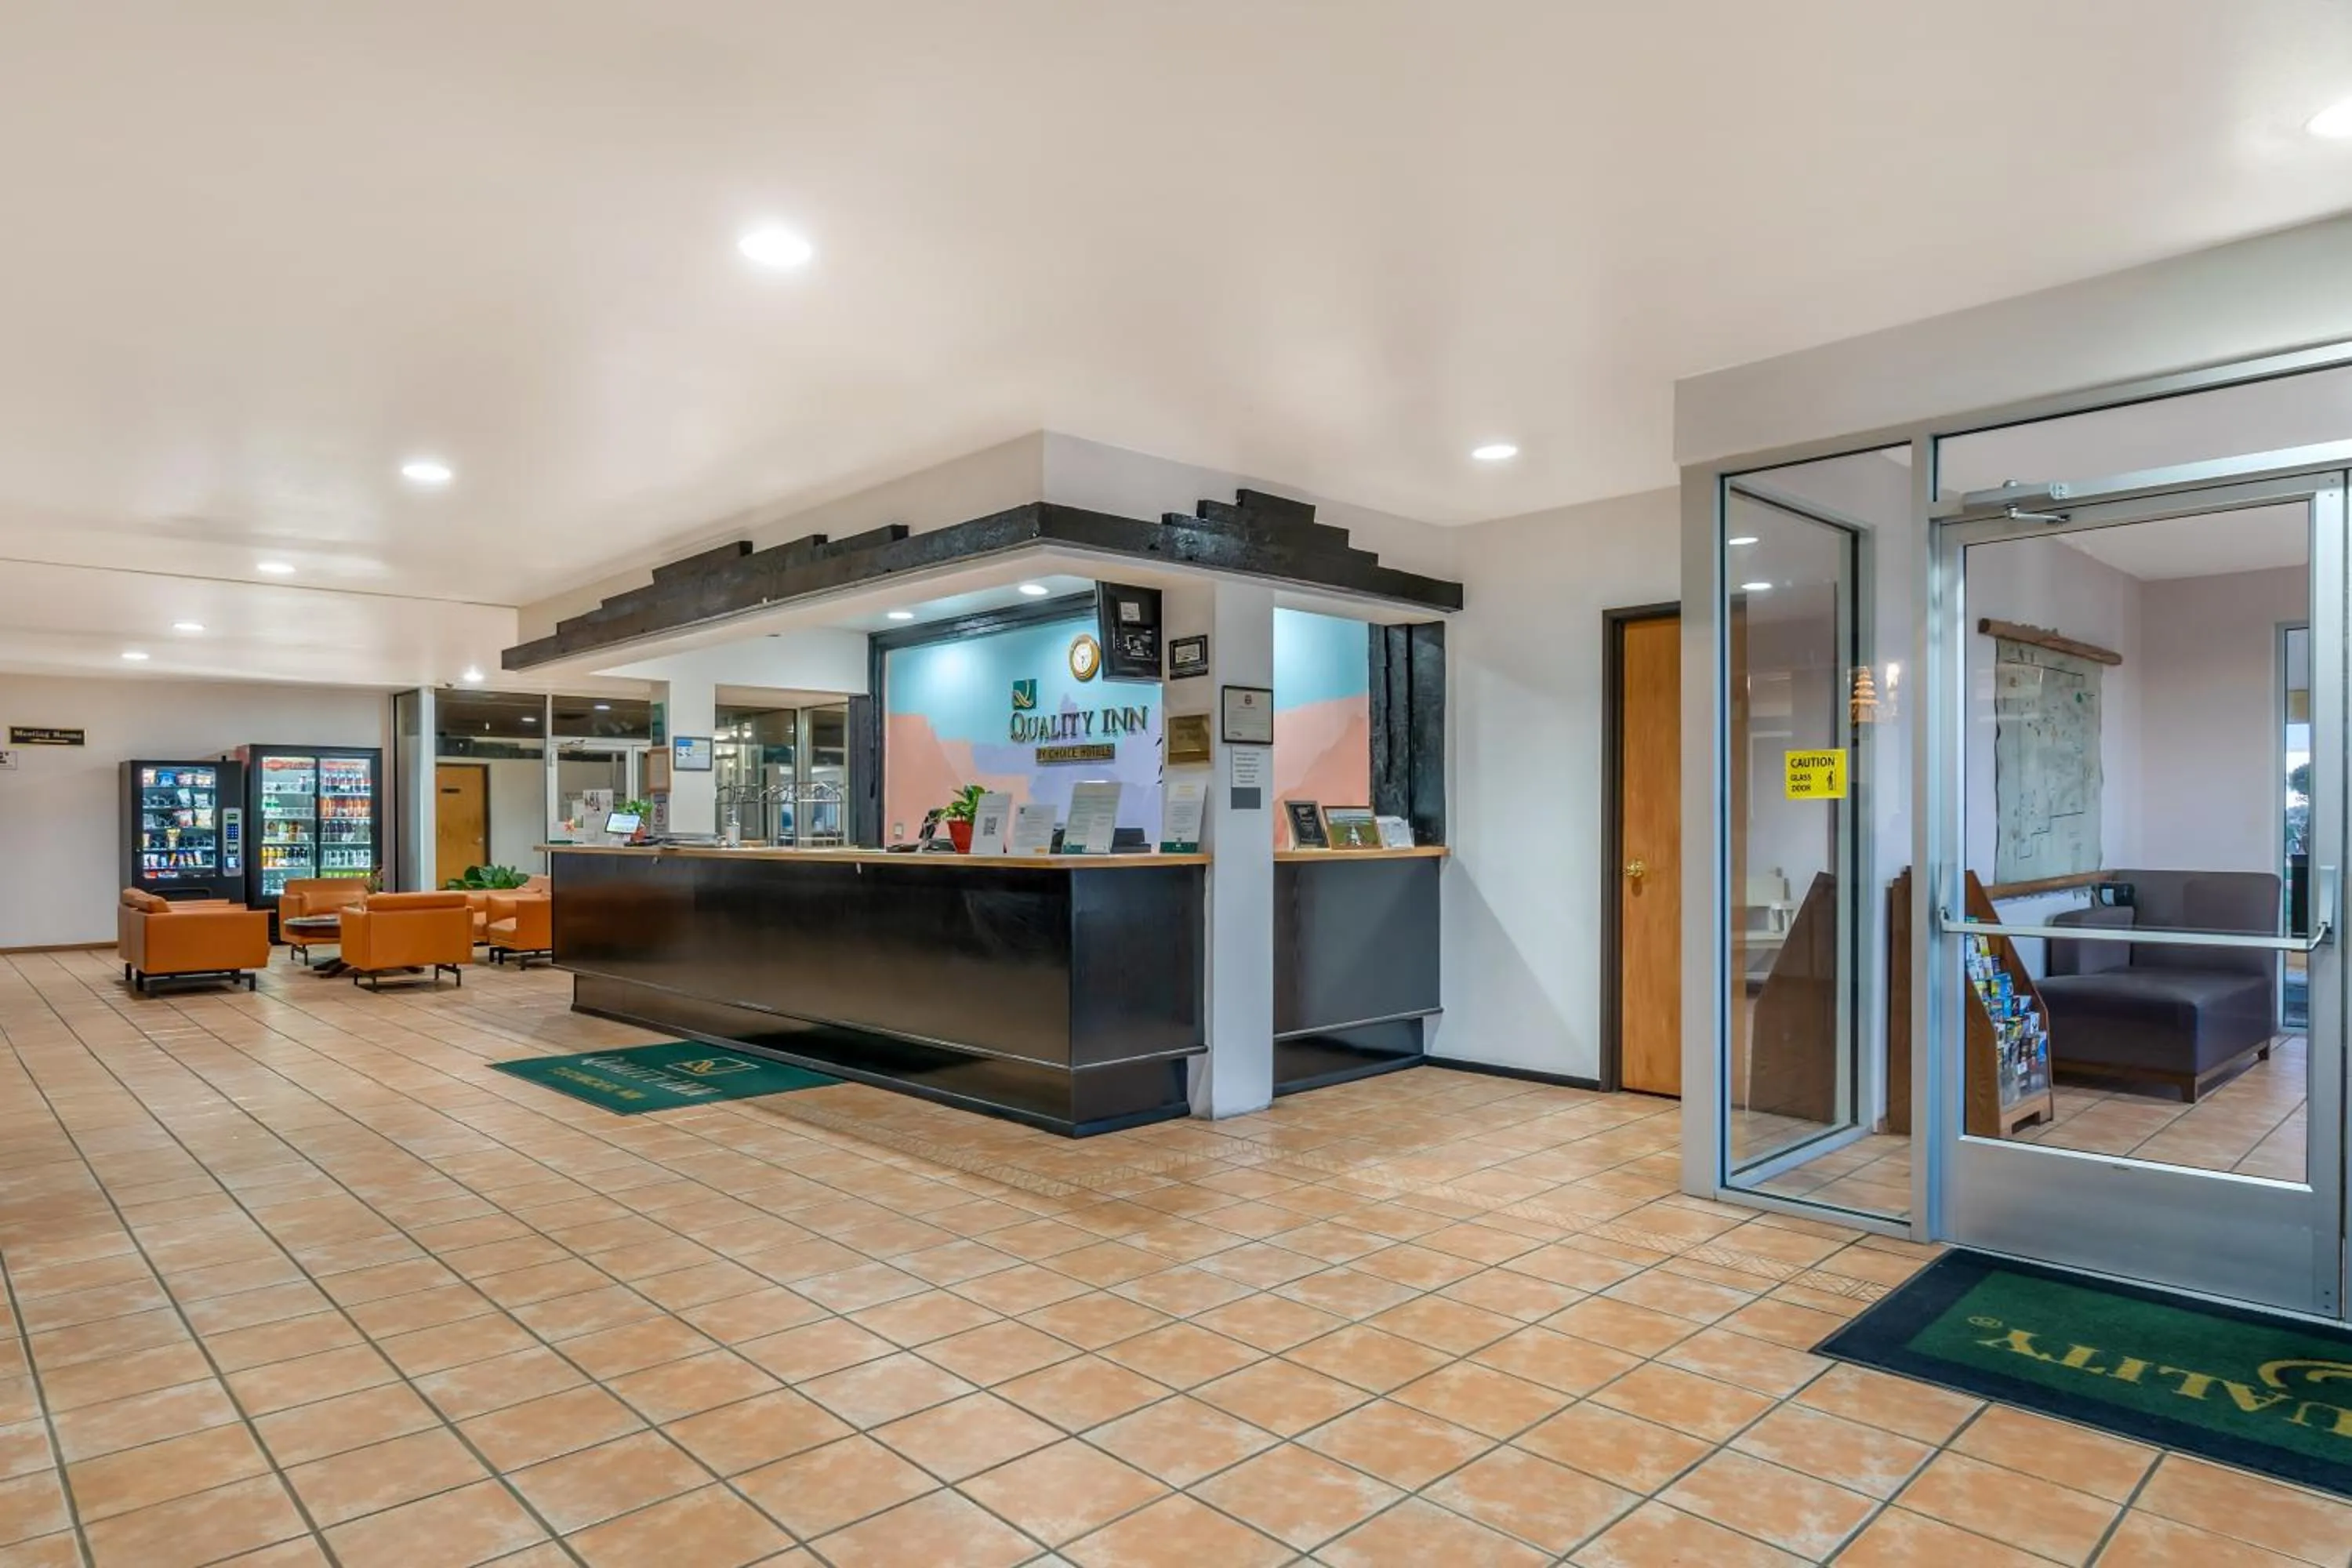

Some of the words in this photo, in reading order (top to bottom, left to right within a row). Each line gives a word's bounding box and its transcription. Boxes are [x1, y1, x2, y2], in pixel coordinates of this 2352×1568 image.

[1010, 710, 1094, 742] QUALITY
[1102, 705, 1149, 735] INN
[1790, 757, 1835, 768] CAUTION
[1790, 773, 1812, 782] GLASS
[1791, 784, 1812, 793] DOOR
[1977, 1330, 2352, 1437] UALITY
